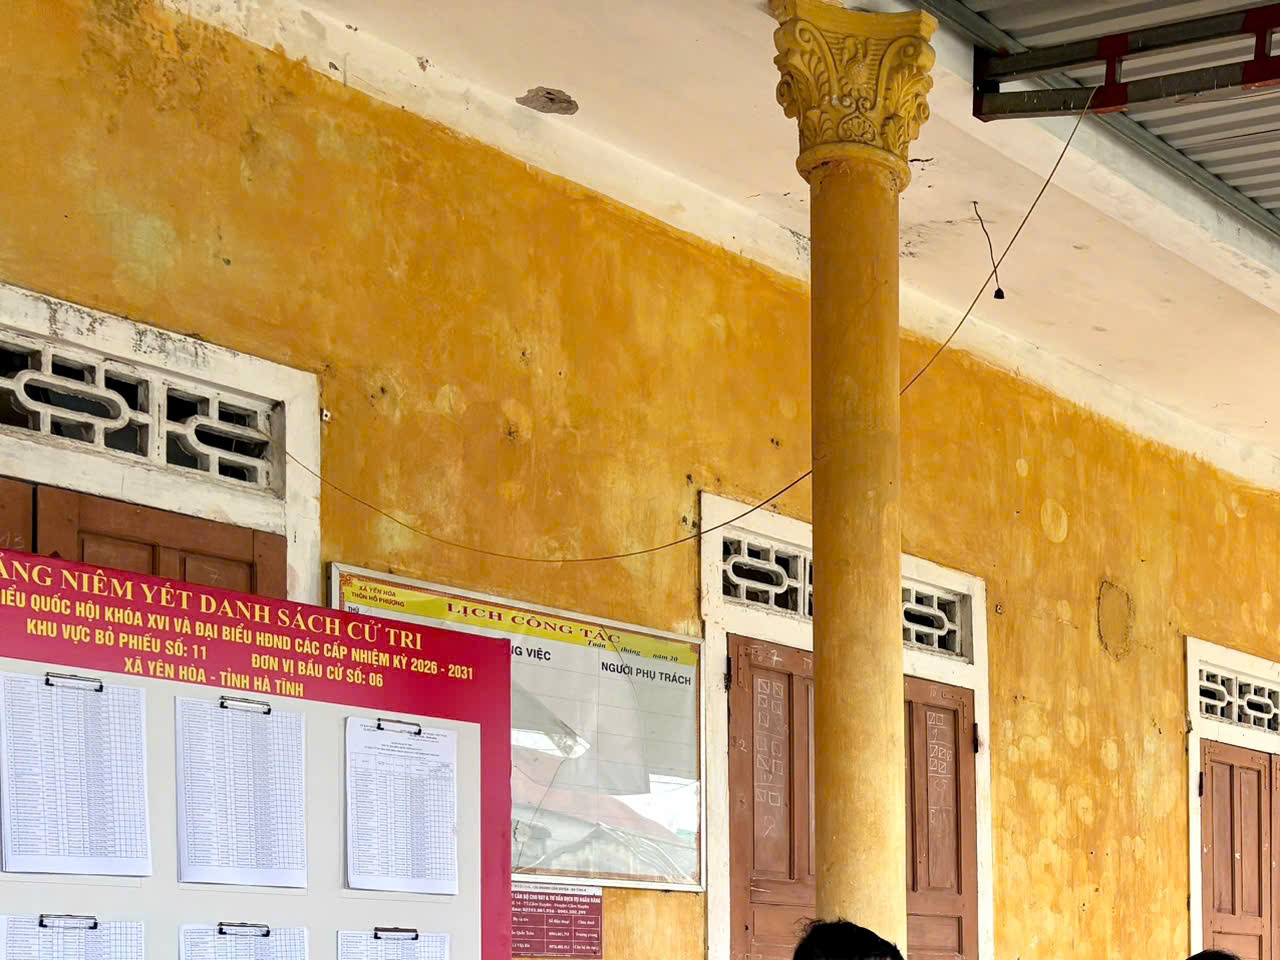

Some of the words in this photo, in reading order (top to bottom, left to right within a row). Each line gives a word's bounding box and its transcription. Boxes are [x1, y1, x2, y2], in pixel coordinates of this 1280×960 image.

[61, 569, 134, 601] NIÊM
[141, 582, 193, 610] YẾT
[200, 593, 271, 625] DANH
[277, 606, 341, 636] SÁCH
[347, 620, 382, 643] CỬ
[385, 628, 423, 650] TRI
[447, 602, 504, 623] LỊCH
[511, 614, 573, 635] CÔNG
[579, 627, 621, 645] TÁC
[26, 618, 57, 638] KHU
[62, 624, 91, 645] VỰC
[95, 626, 114, 647] BỎ
[119, 632, 161, 653] PHIẾU
[165, 637, 188, 657] SỐ:
[192, 645, 207, 660] 11
[31, 593, 71, 615] QUỐC
[75, 601, 100, 621] HỘI
[105, 605, 143, 627] KHÓA
[147, 613, 170, 631] XVI
[174, 616, 191, 635] VÀ
[195, 621, 218, 641] ĐẠI
[222, 622, 252, 644] BIỂU
[256, 631, 291, 650] HĐND
[295, 637, 320, 656] CÁC
[323, 640, 348, 660] CẤP
[351, 648, 390, 668] NHIỆM
[393, 653, 408, 671] KỲ
[411, 658, 438, 675] 2026
[448, 664, 473, 680] 2031
[526, 647, 551, 661] VIỆC
[124, 656, 143, 674] XÃ
[148, 659, 175, 679] YÊN
[179, 663, 207, 683] HÒA
[219, 667, 250, 688] TỈNH
[254, 674, 271, 692] HÀ
[275, 677, 305, 697] TĨNH
[251, 653, 279, 672] ĐƠN
[283, 658, 294, 677] VỊ
[327, 662, 344, 681] CỬ
[346, 666, 366, 685] SỐ:
[369, 673, 384, 687] 06
[601, 661, 633, 677] NGƯỜI
[636, 668, 656, 681] PHỤ
[659, 669, 691, 686] TRÁCH
